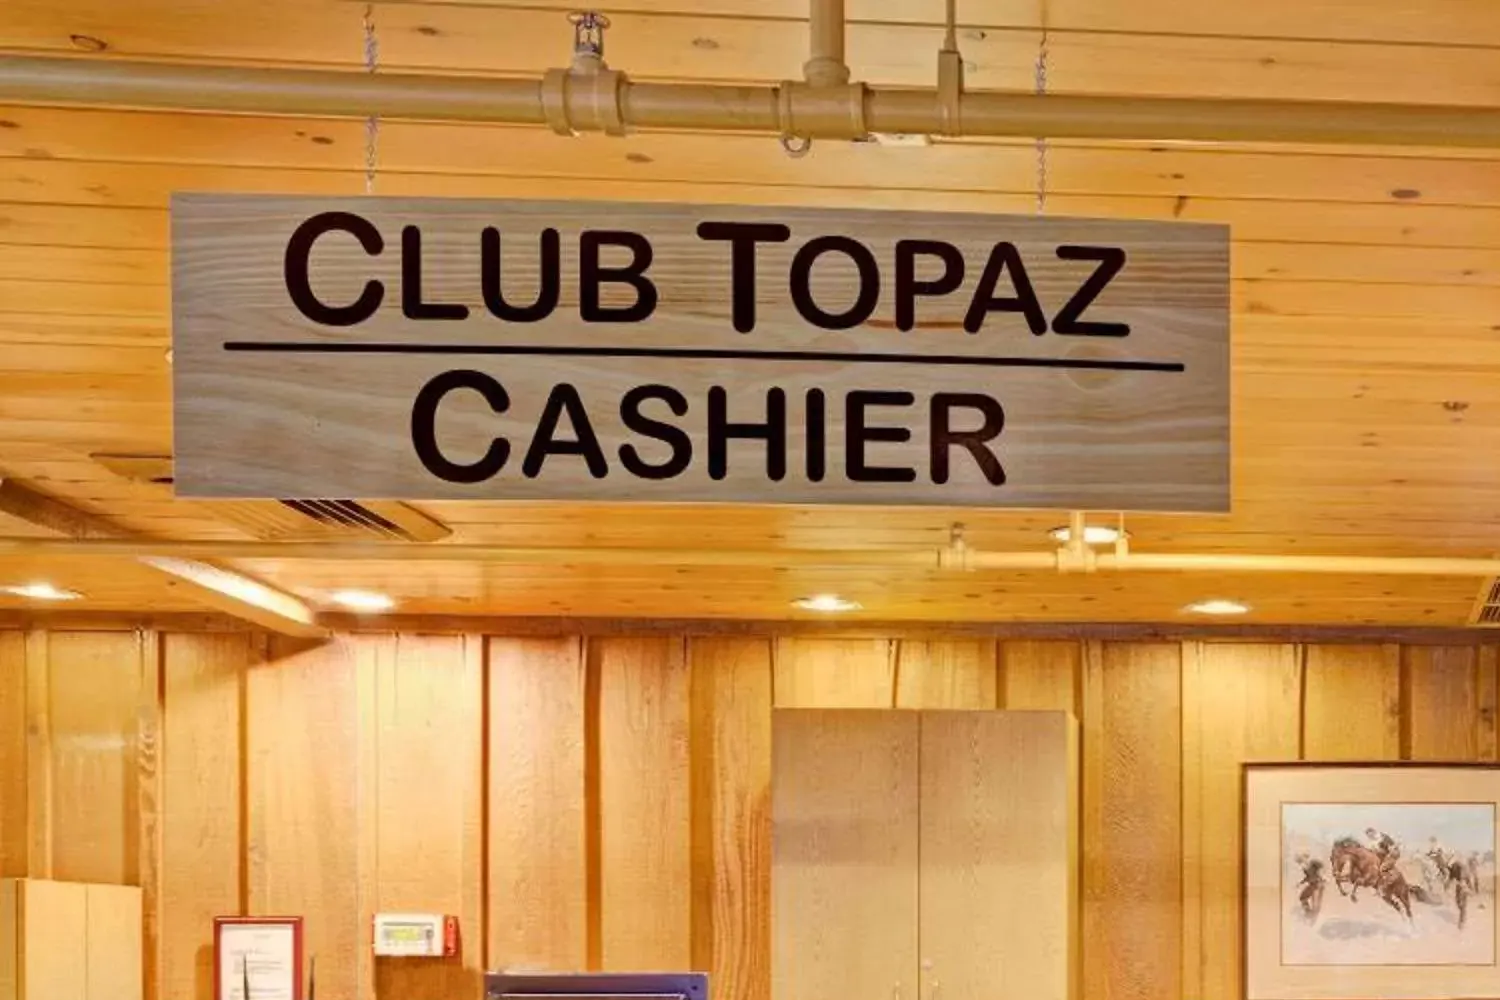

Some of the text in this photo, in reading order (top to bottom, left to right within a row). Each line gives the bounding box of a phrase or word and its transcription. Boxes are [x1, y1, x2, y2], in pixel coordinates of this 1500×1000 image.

[284, 211, 1131, 338] CLUB TOPAZ
[410, 369, 1007, 486] CASHIER
